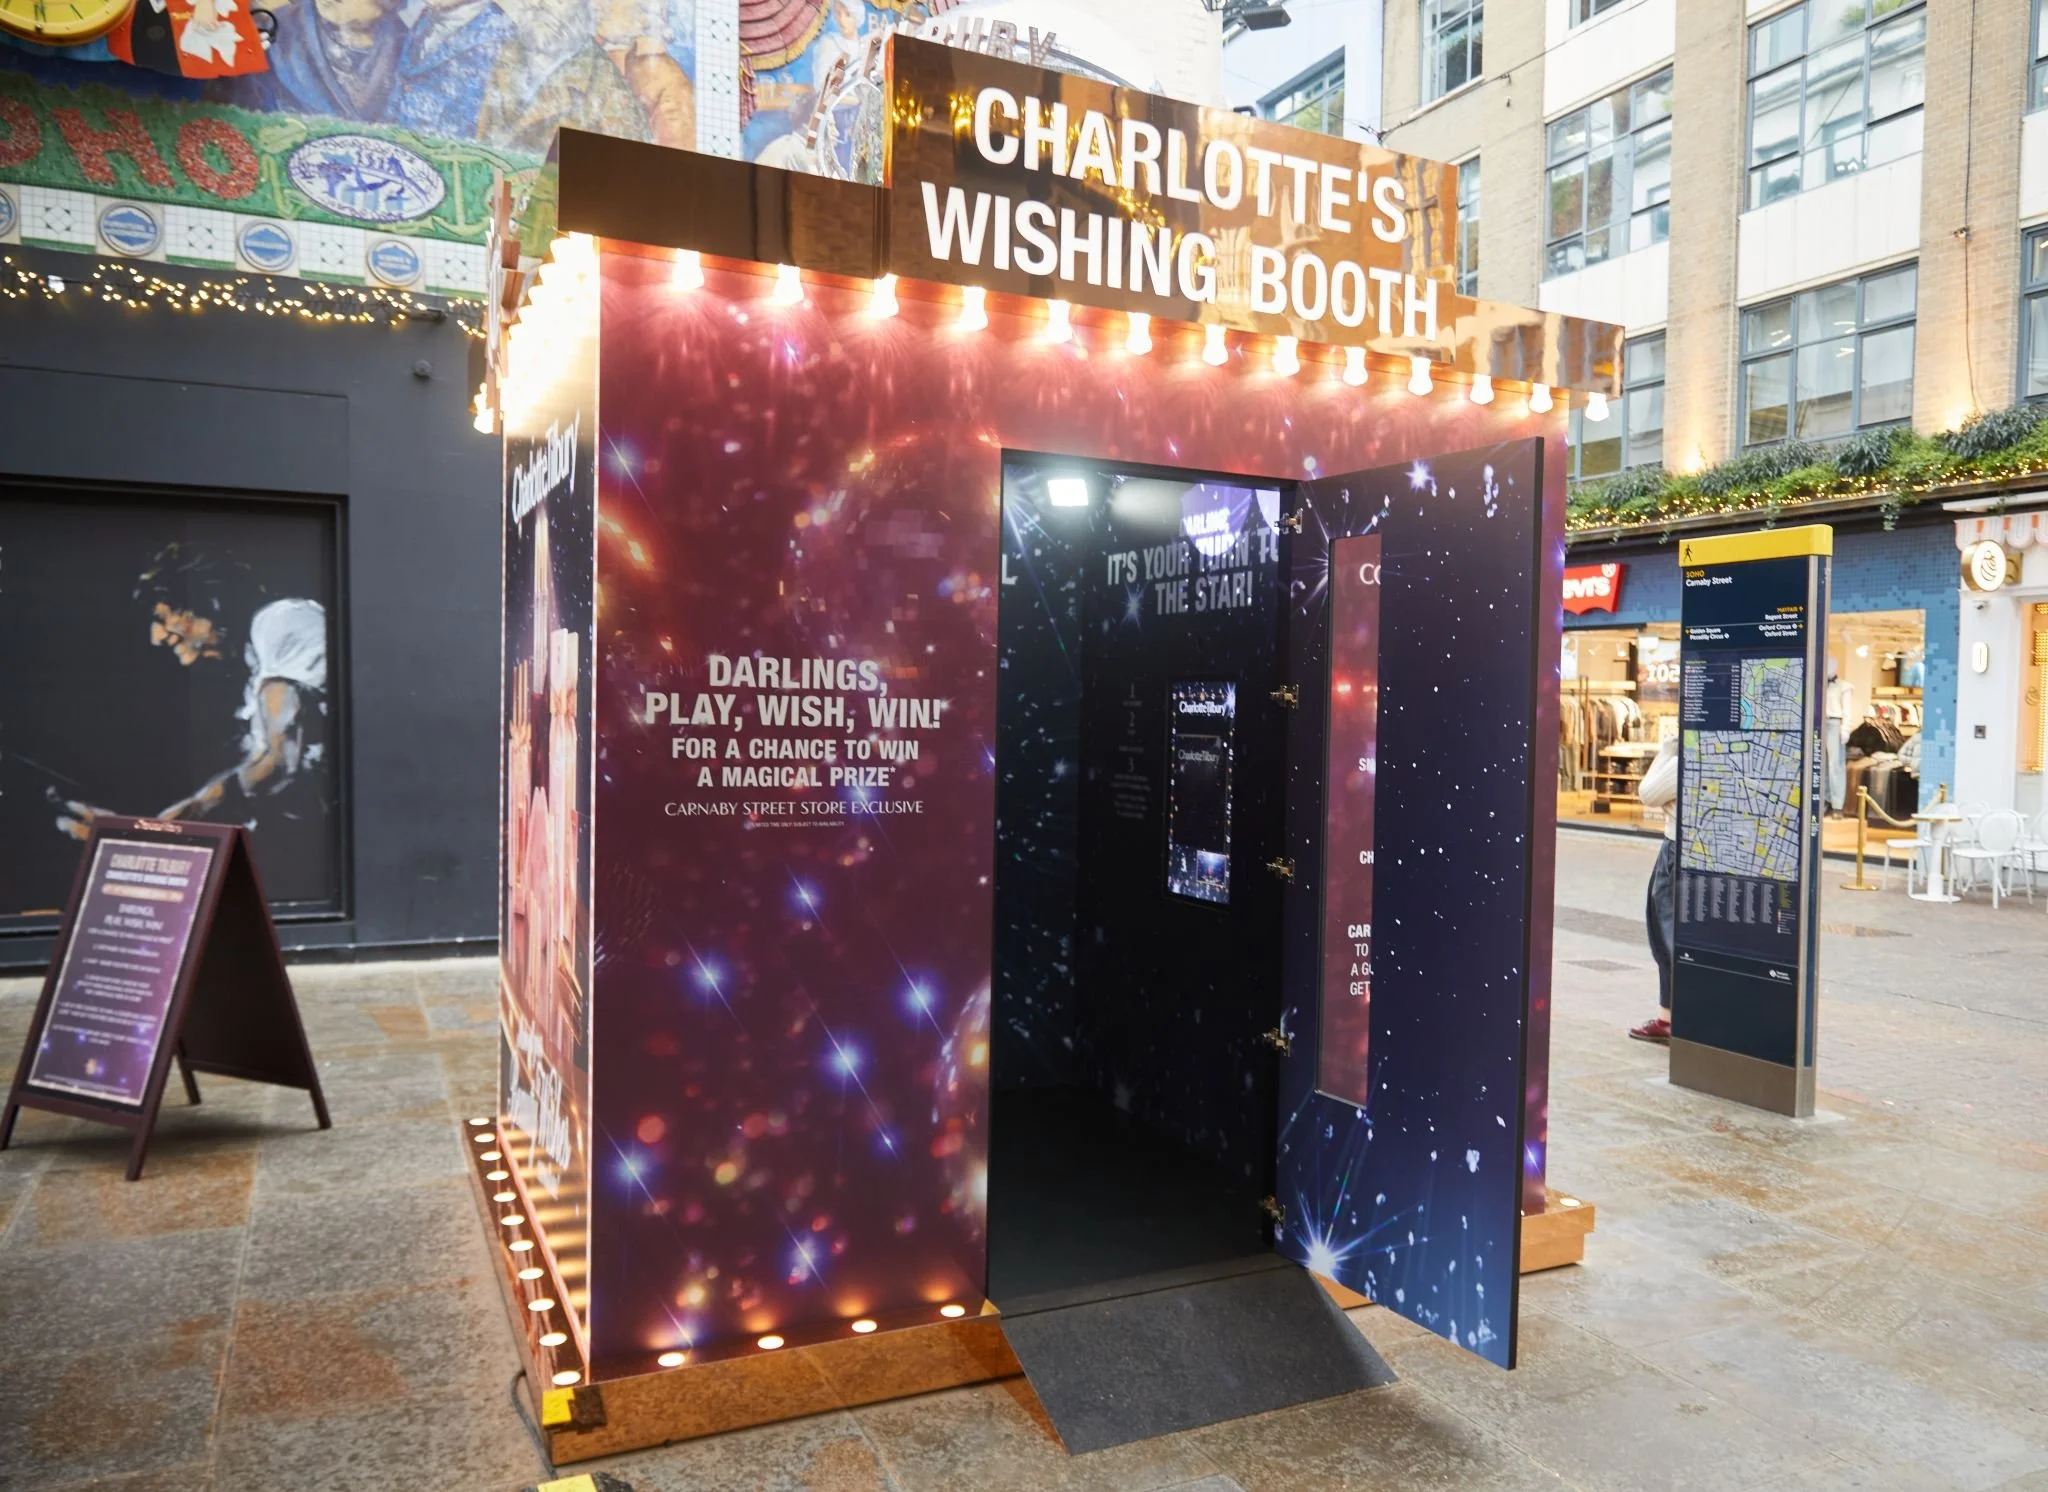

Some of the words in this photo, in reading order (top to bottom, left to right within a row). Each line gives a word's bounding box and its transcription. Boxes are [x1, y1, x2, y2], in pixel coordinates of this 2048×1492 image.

[0, 96, 260, 200] OHO
[975, 86, 1408, 244] CHARLOTTE'S
[920, 181, 1217, 305] WISHING
[1250, 244, 1438, 342] BOOTH
[1107, 552, 1138, 586] IT'S
[1144, 541, 1190, 579] YOUR
[1685, 578, 1711, 587] Carnaby
[1712, 576, 1733, 585] Street
[1686, 570, 1705, 579] SOHO
[1155, 580, 1189, 615] THE
[1195, 571, 1253, 612] STAR!
[708, 655, 888, 698] DARLINGS,
[645, 692, 743, 733] PLAY,
[759, 695, 855, 733] WISH,
[869, 698, 941, 729] WIN!
[671, 738, 717, 760] FOR
[725, 738, 741, 760] A
[749, 738, 837, 760] CHANCE
[845, 739, 874, 760] TO
[878, 739, 919, 760] WIN
[697, 766, 714, 788] A
[722, 766, 822, 788] MAGICAL
[665, 801, 738, 817] CARNABY
[742, 801, 795, 816] STREET
[801, 801, 847, 816] STORE
[851, 800, 923, 815] EXCLUSIVE
[1347, 924, 1372, 939] CAR
